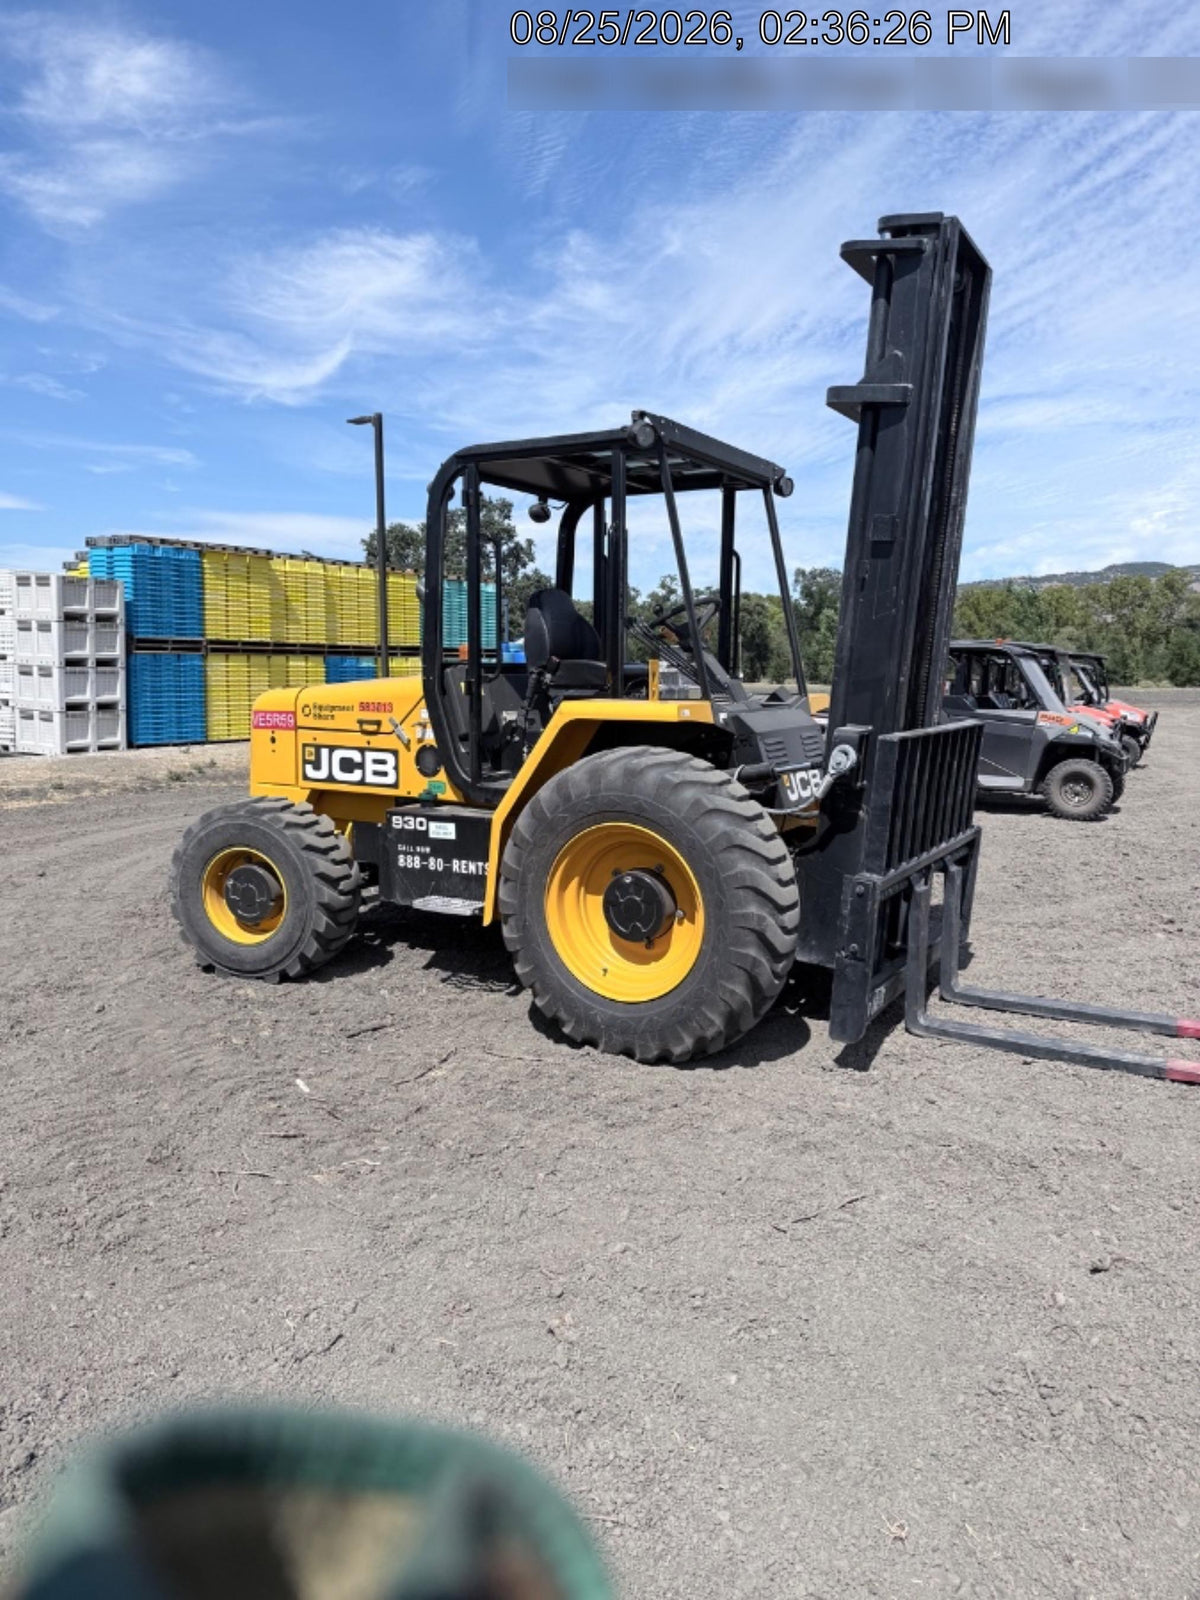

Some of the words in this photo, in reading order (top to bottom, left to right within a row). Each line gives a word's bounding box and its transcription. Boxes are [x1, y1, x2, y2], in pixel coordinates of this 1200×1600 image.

[305, 748, 398, 785] JCB
[786, 769, 823, 801] JCB
[392, 815, 428, 831] 930
